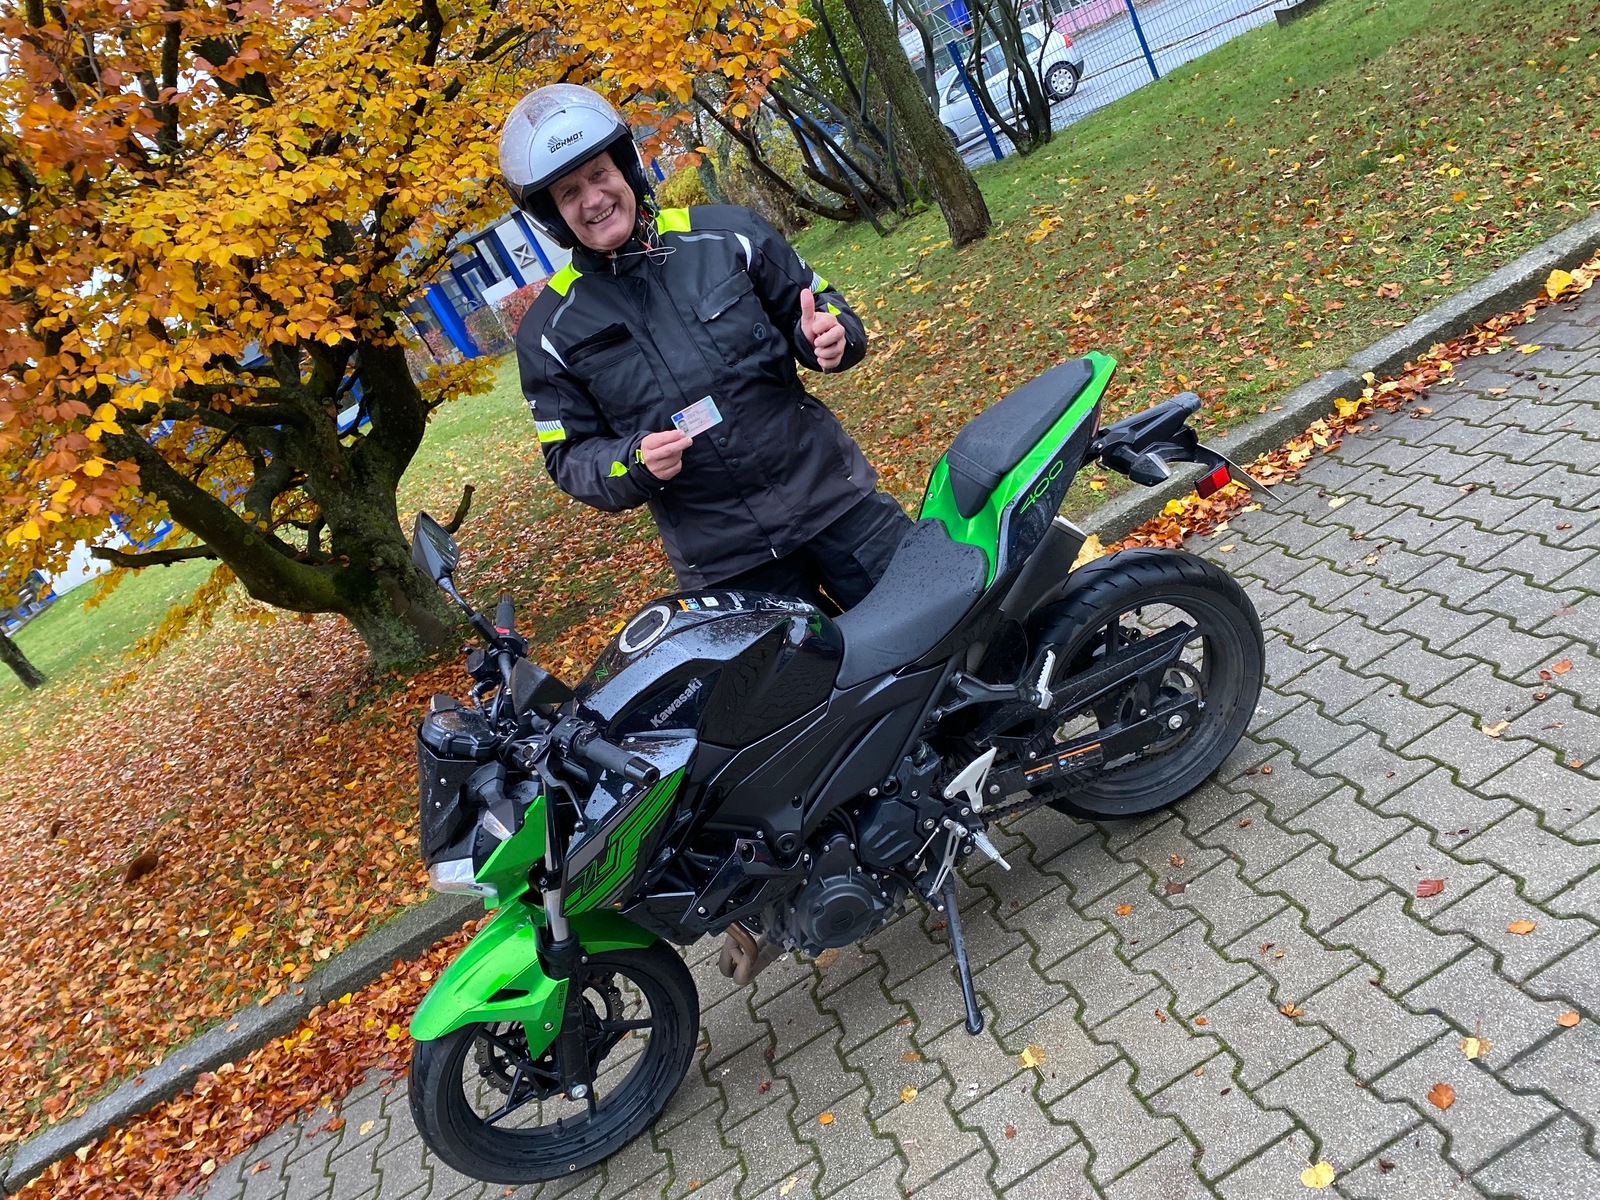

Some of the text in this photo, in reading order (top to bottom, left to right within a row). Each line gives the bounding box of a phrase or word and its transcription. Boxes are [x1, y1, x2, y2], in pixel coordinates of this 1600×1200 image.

[1019, 459, 1064, 515] 400
[650, 677, 703, 728] Kawasaki
[557, 983, 566, 1010] ABS
